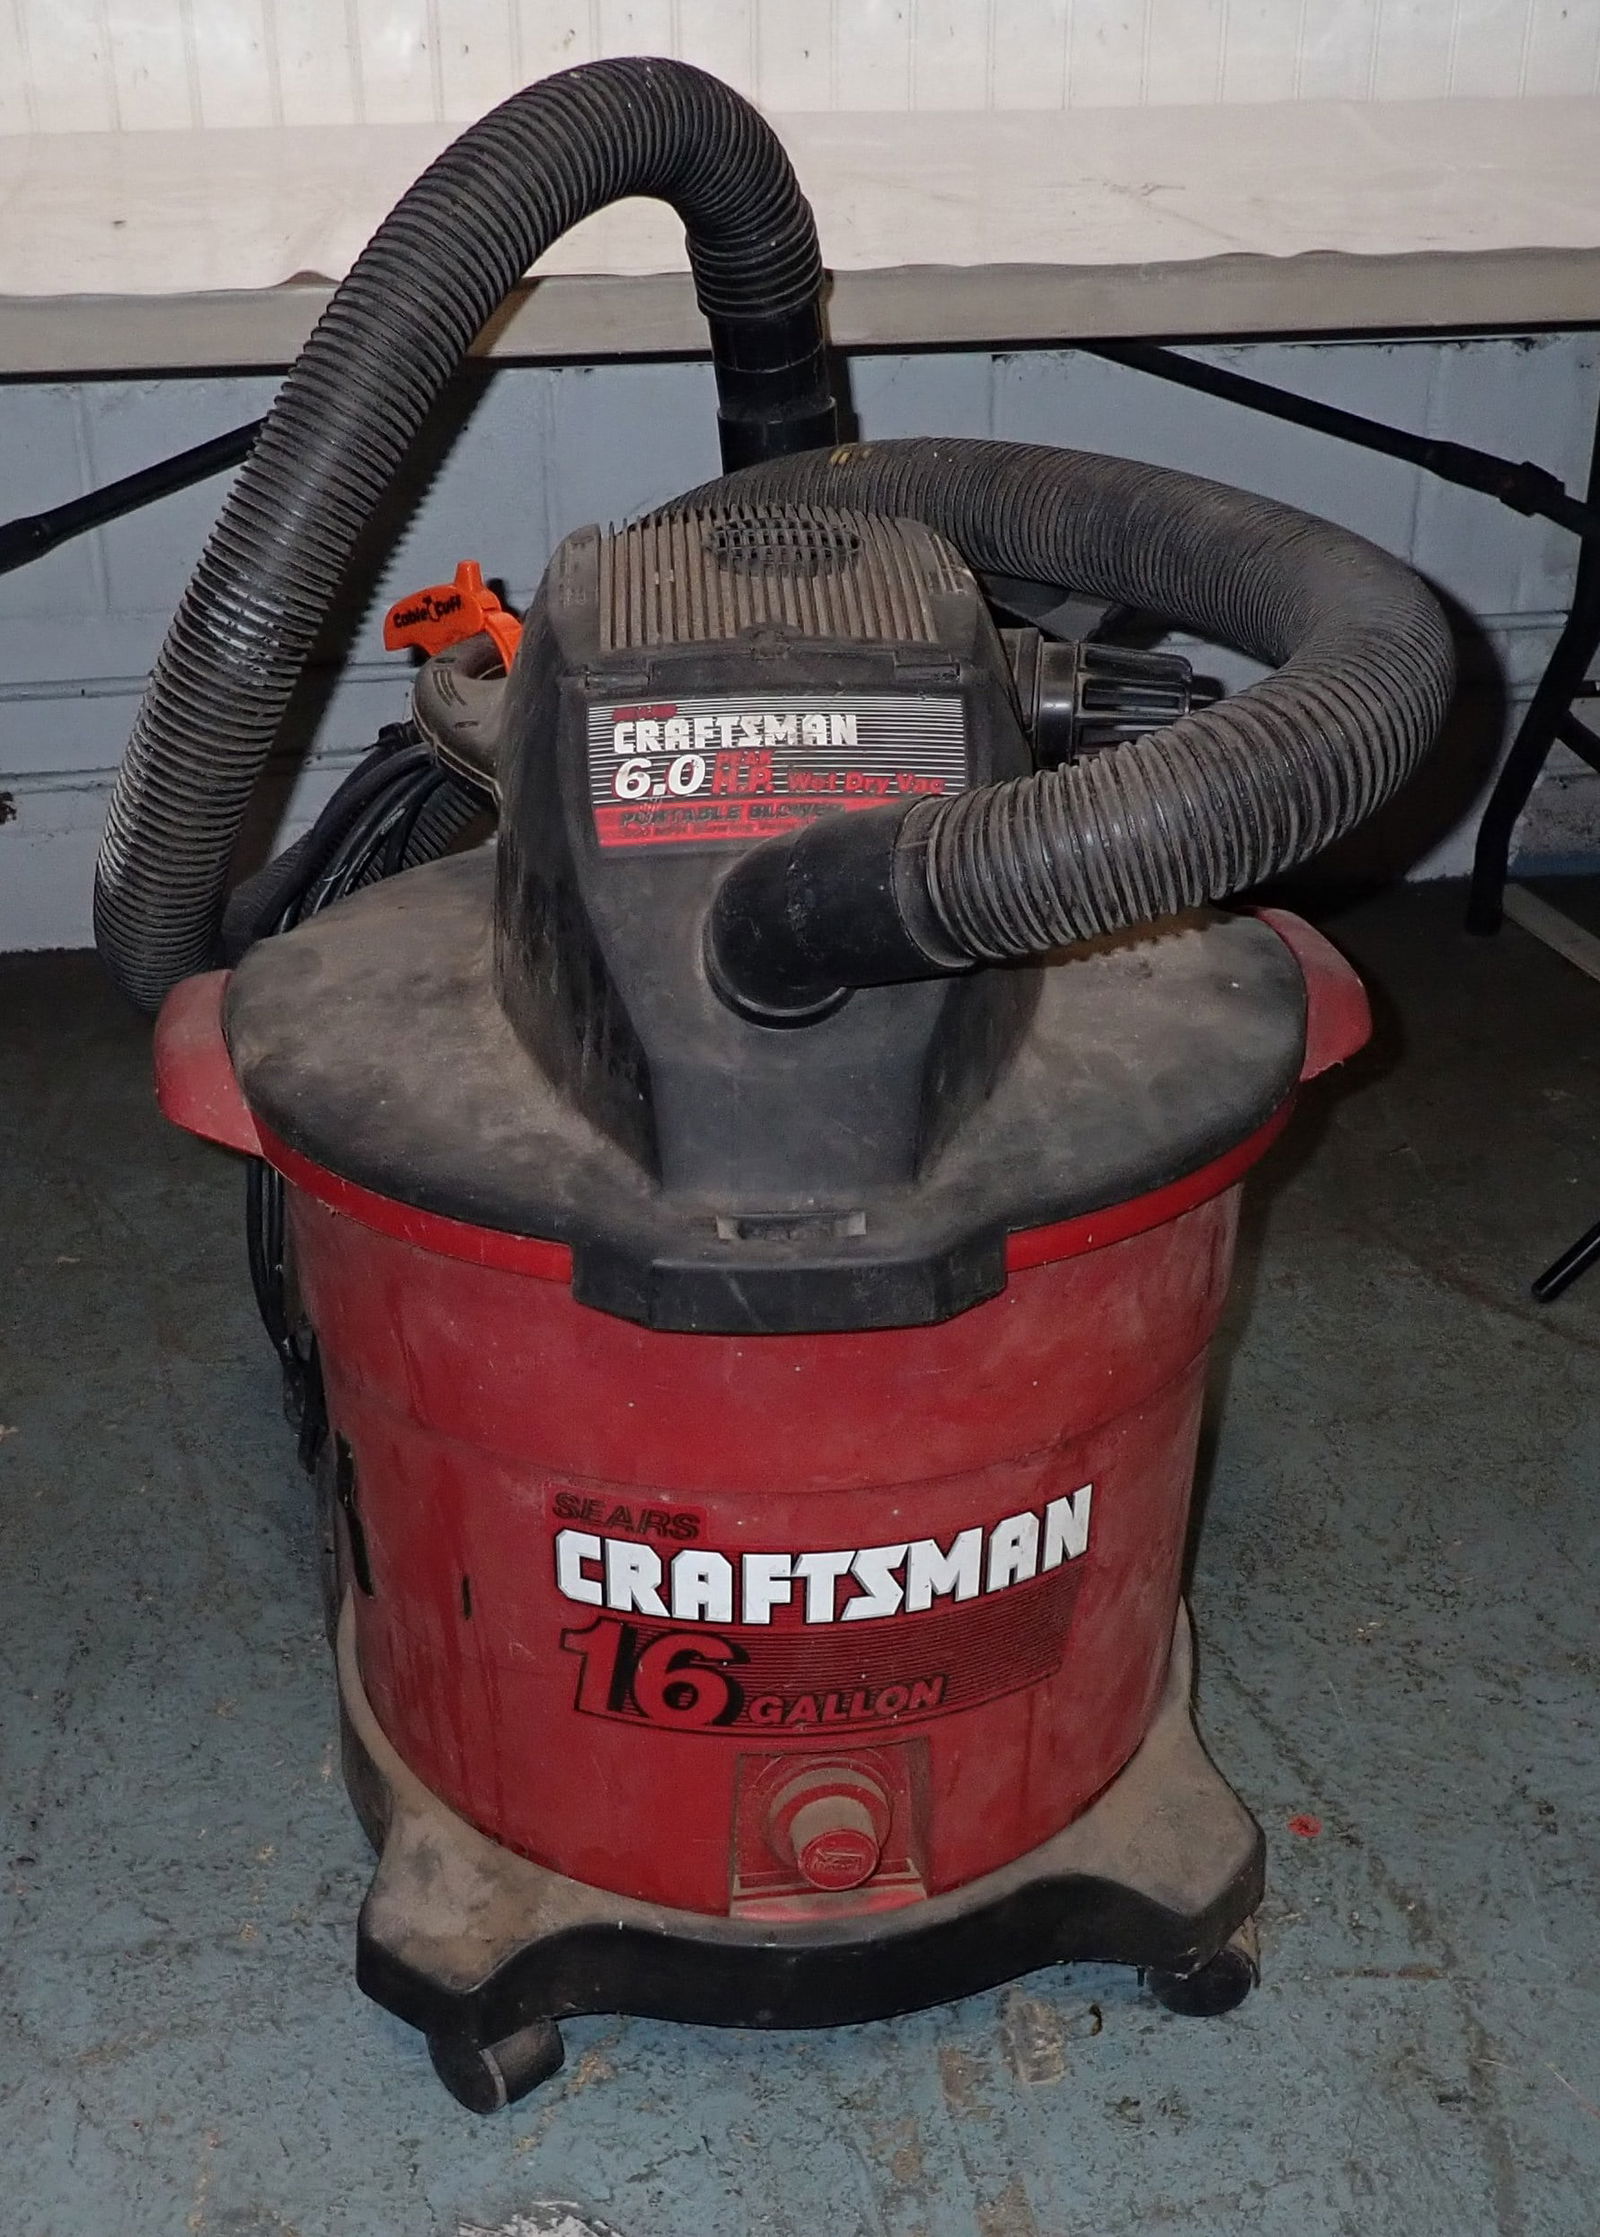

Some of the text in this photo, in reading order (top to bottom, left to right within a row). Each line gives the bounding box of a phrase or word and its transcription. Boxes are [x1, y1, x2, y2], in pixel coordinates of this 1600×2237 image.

[393, 594, 462, 628] Cable Cuff
[613, 714, 859, 754] CRAFTSMAN
[611, 754, 706, 799] 6.0
[787, 771, 838, 791] Wet
[845, 771, 891, 793] Dry
[896, 772, 946, 794] Vac
[551, 1492, 702, 1541] SEARS
[554, 1482, 1095, 1626] CRAFTSMAN
[560, 1616, 951, 1728] 16 GALLON
